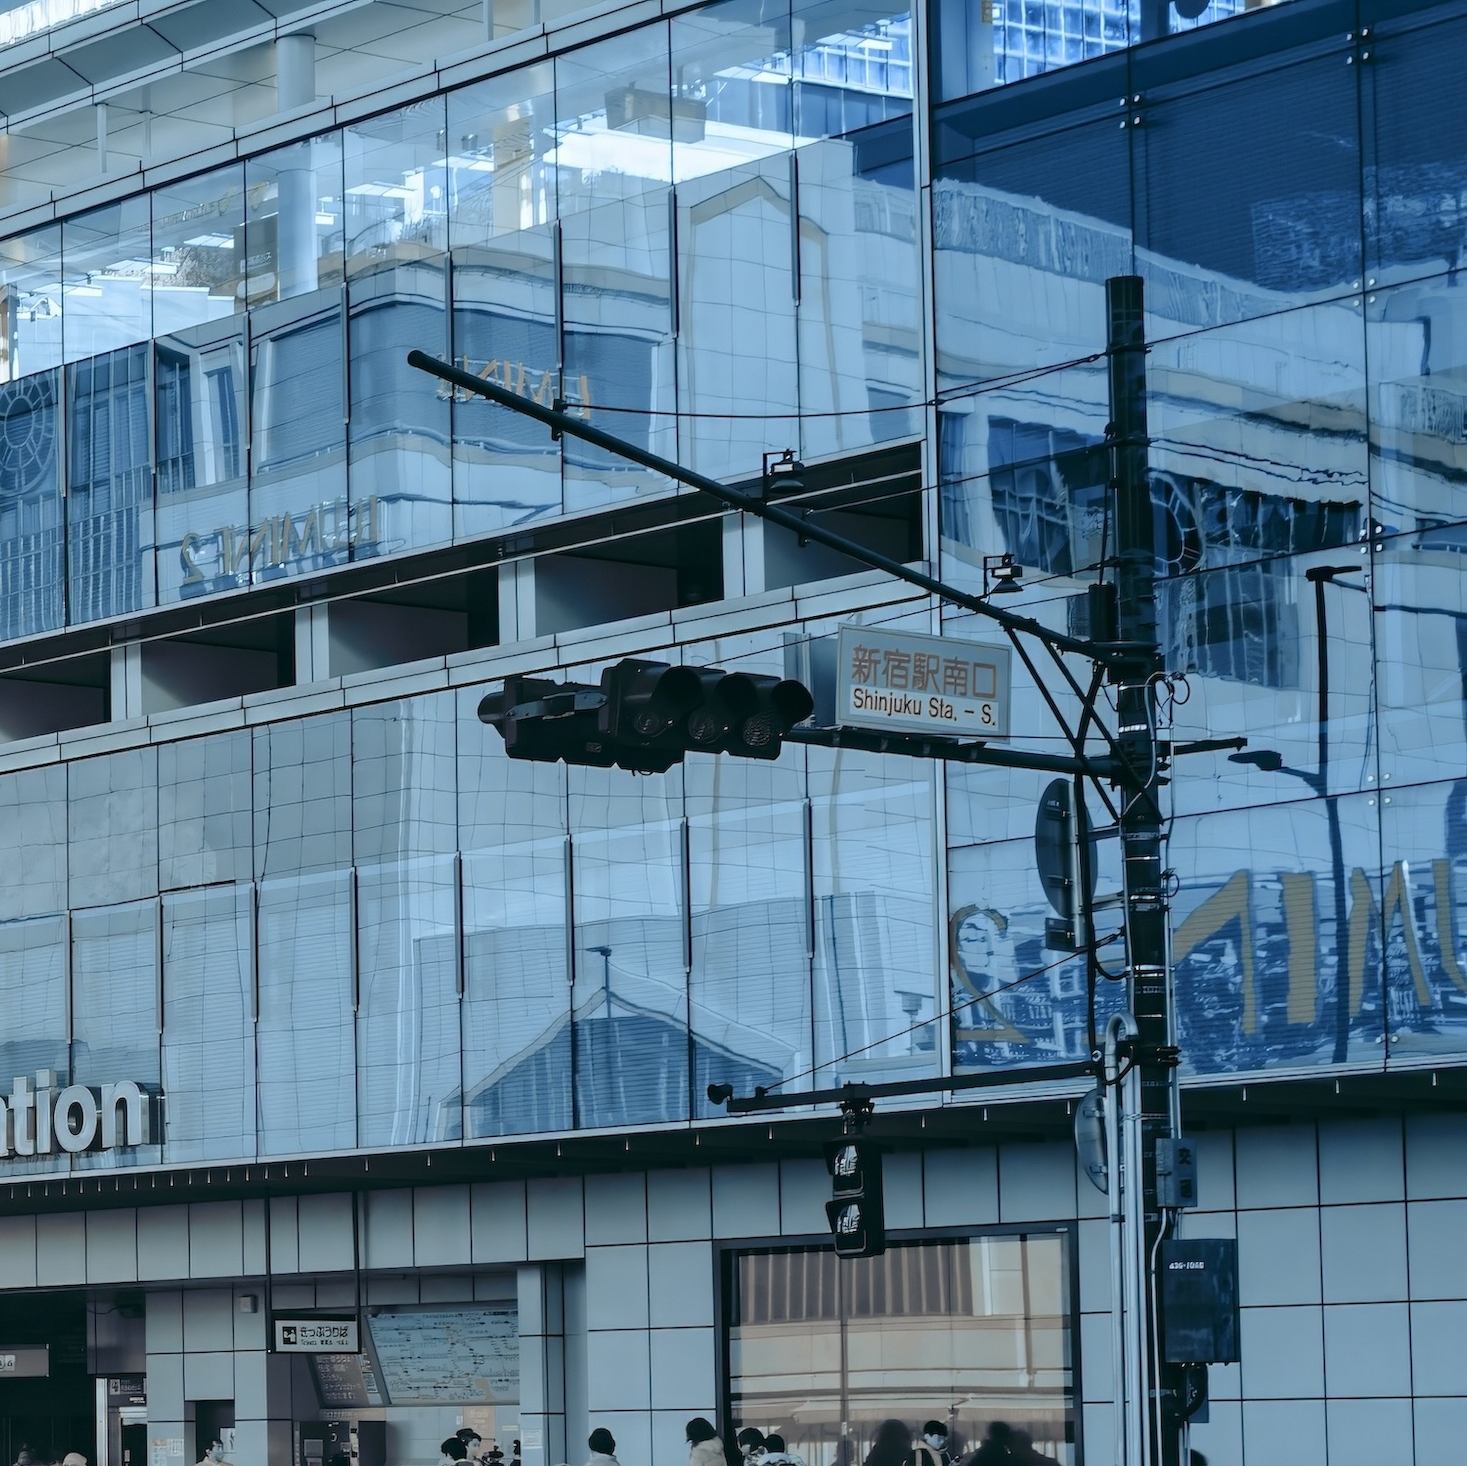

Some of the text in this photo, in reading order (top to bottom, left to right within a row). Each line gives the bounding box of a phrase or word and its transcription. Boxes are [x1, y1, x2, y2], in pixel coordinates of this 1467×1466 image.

[852, 644, 996, 699] 新宿駅南口
[853, 688, 922, 717] Shinjuku
[928, 697, 958, 722] Sta.
[981, 703, 996, 726] S.
